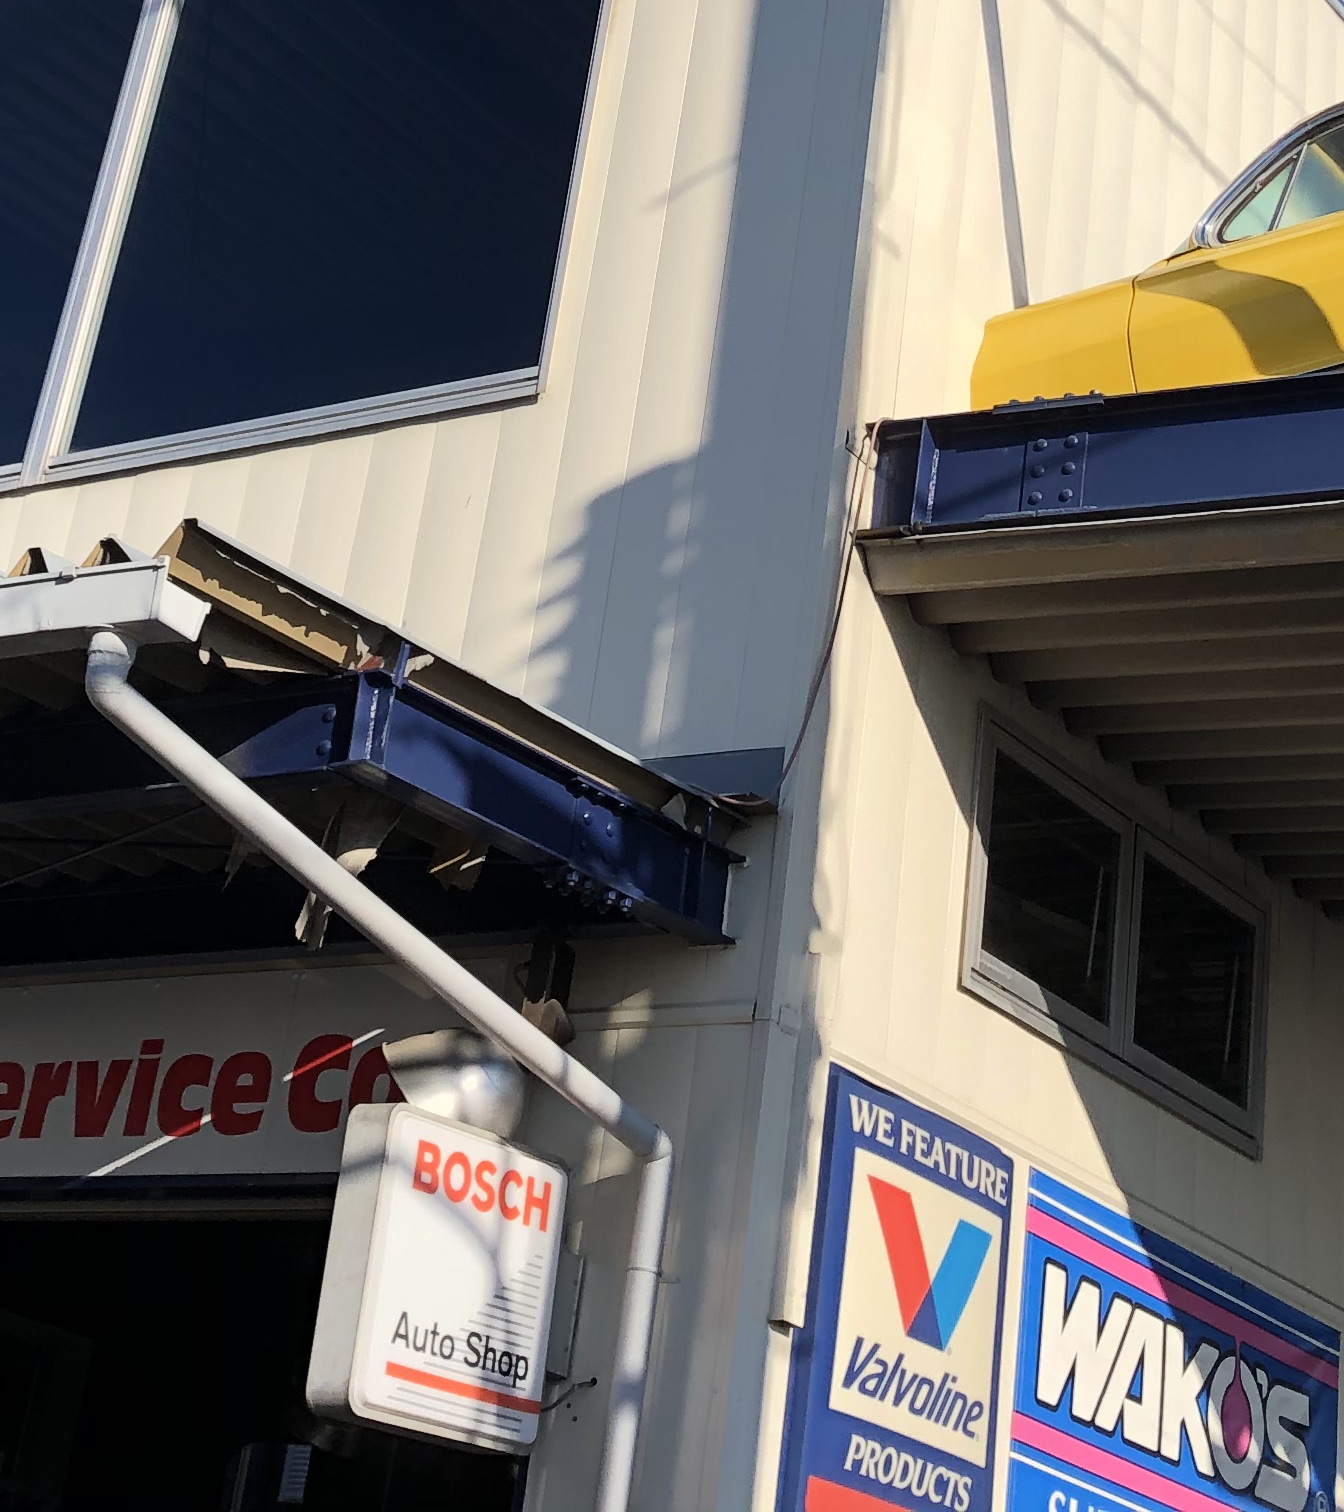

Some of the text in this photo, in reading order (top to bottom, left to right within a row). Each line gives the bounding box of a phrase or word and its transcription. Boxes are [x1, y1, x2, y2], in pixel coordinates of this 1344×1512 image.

[412, 1139, 552, 1233] BOSCH
[848, 1093, 1009, 1207] WE FEATURE
[391, 1311, 529, 1388] Auto Shop
[842, 1335, 984, 1439] Valvoline
[1035, 1257, 1311, 1512] WAKO'S
[843, 1433, 973, 1512] PRODUCTS
